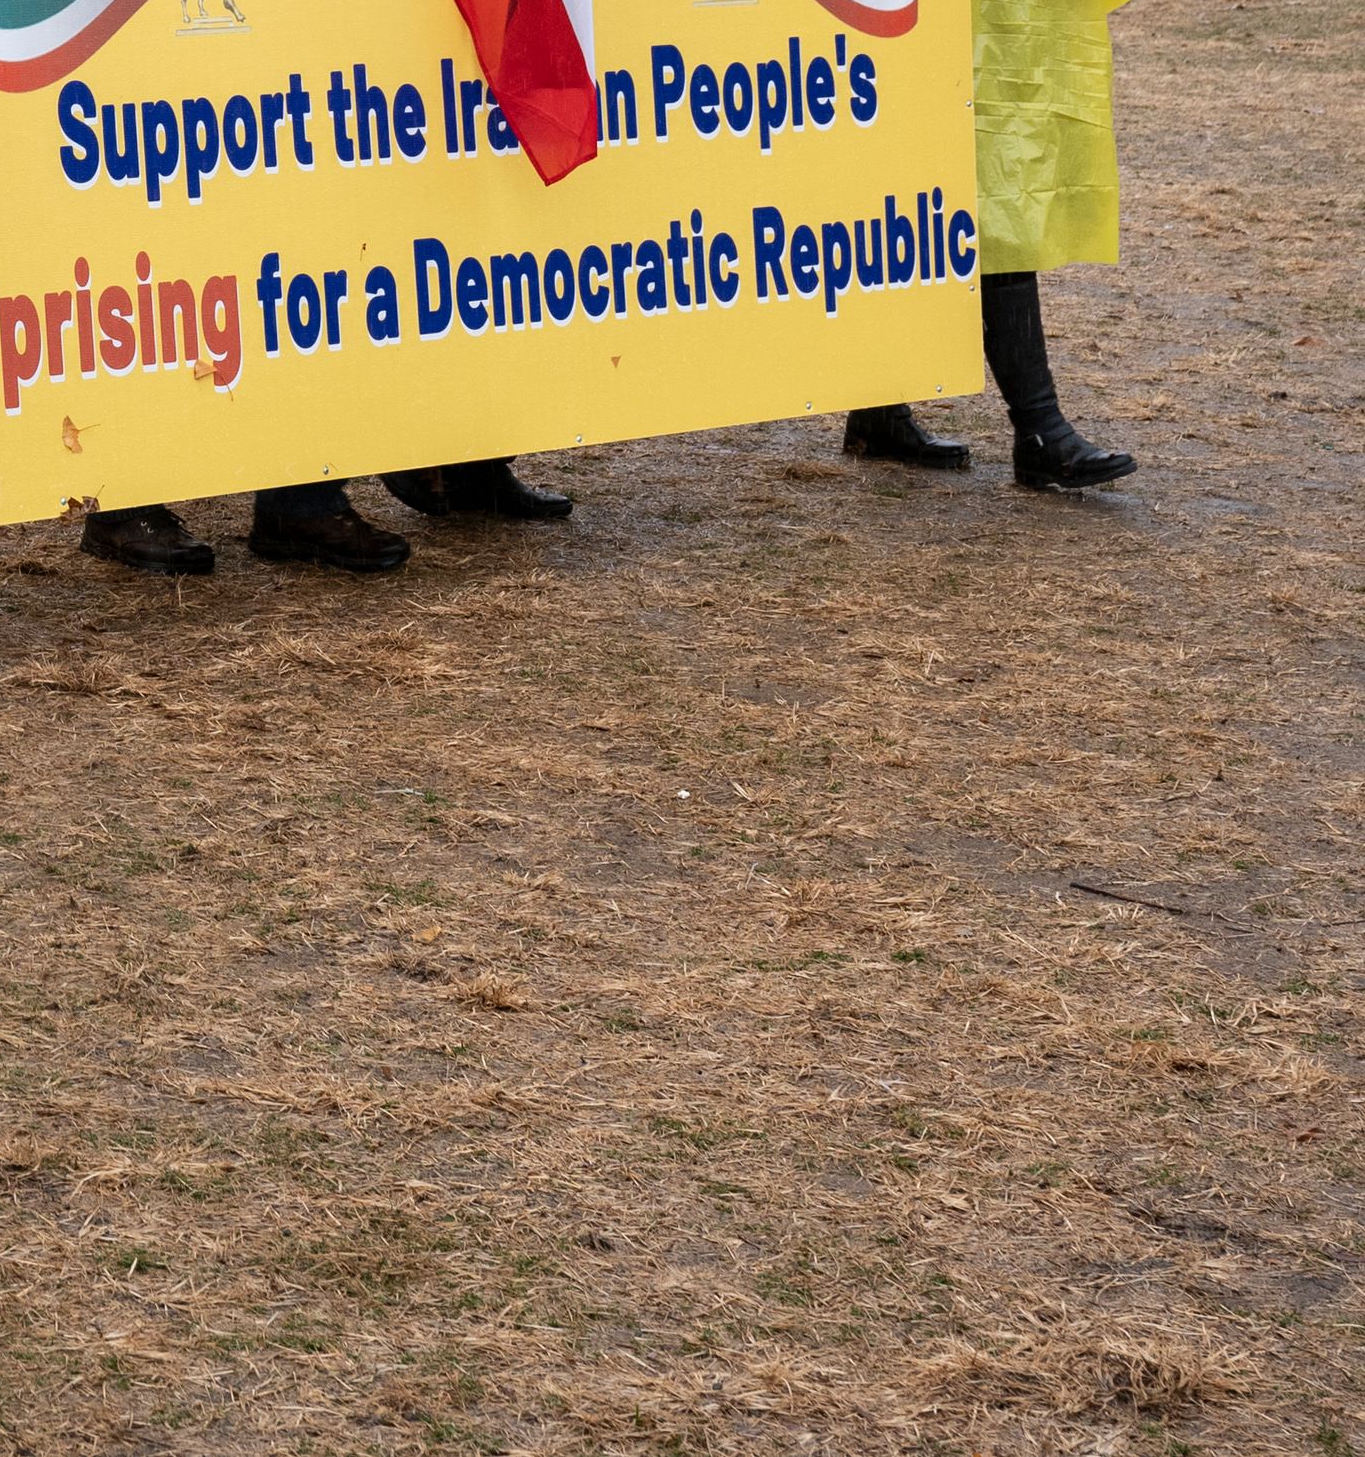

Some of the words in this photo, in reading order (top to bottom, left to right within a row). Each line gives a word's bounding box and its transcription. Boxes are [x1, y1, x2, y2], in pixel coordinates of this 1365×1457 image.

[57, 73, 314, 208] Support
[327, 63, 427, 167] the
[650, 33, 878, 155] People's
[256, 252, 348, 359] for
[363, 265, 401, 346] a
[413, 208, 740, 341] Democratic
[751, 186, 978, 320] Republic
